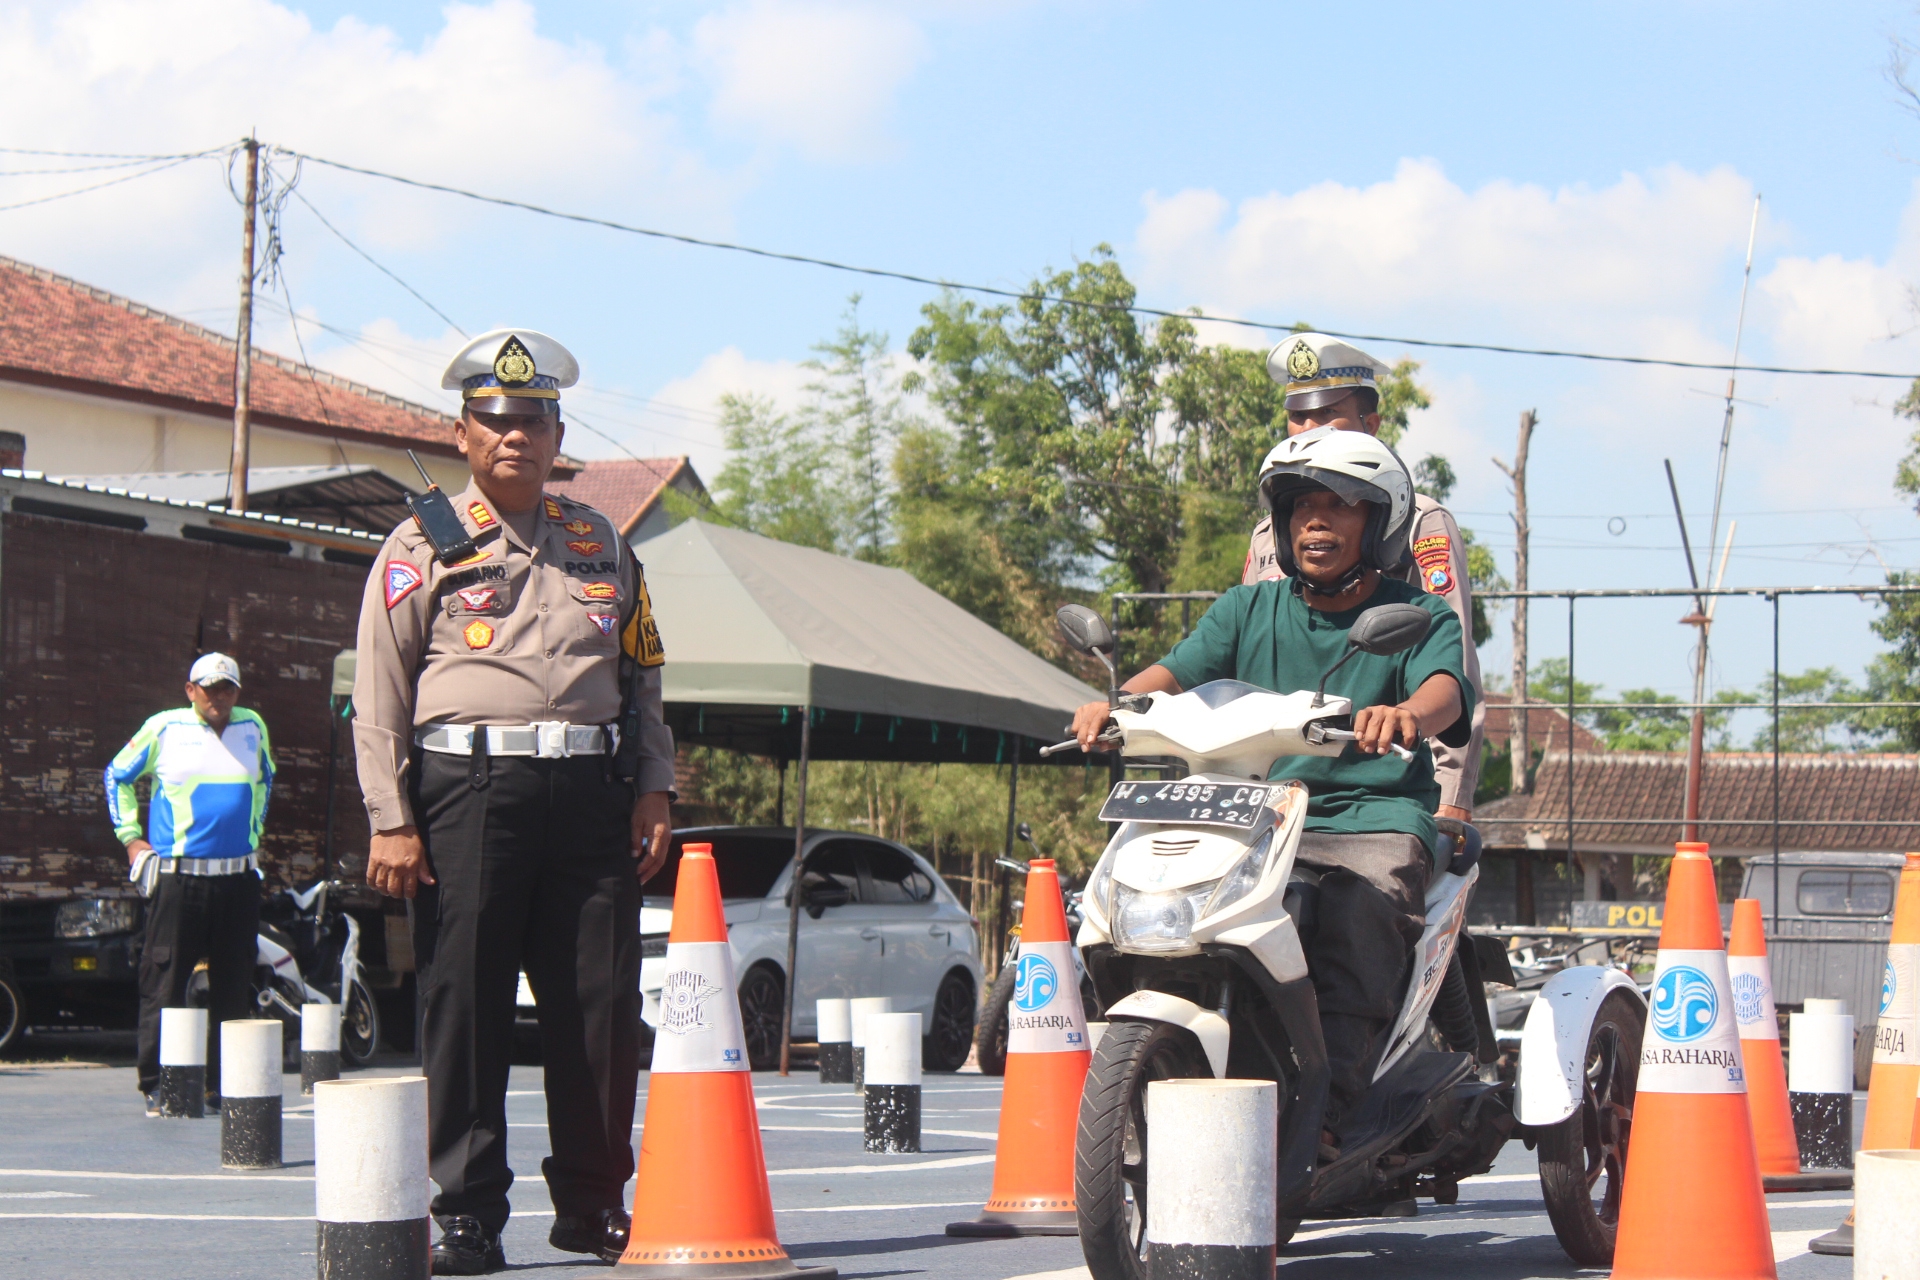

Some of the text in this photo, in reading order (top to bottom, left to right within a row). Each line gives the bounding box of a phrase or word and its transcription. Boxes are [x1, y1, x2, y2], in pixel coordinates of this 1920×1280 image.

[564, 561, 617, 575] POLRI
[1114, 784, 1138, 799] W
[1154, 783, 1217, 802] 4595
[1017, 1015, 1073, 1030] RAHARJA
[1662, 1049, 1737, 1068] RAHARJA
